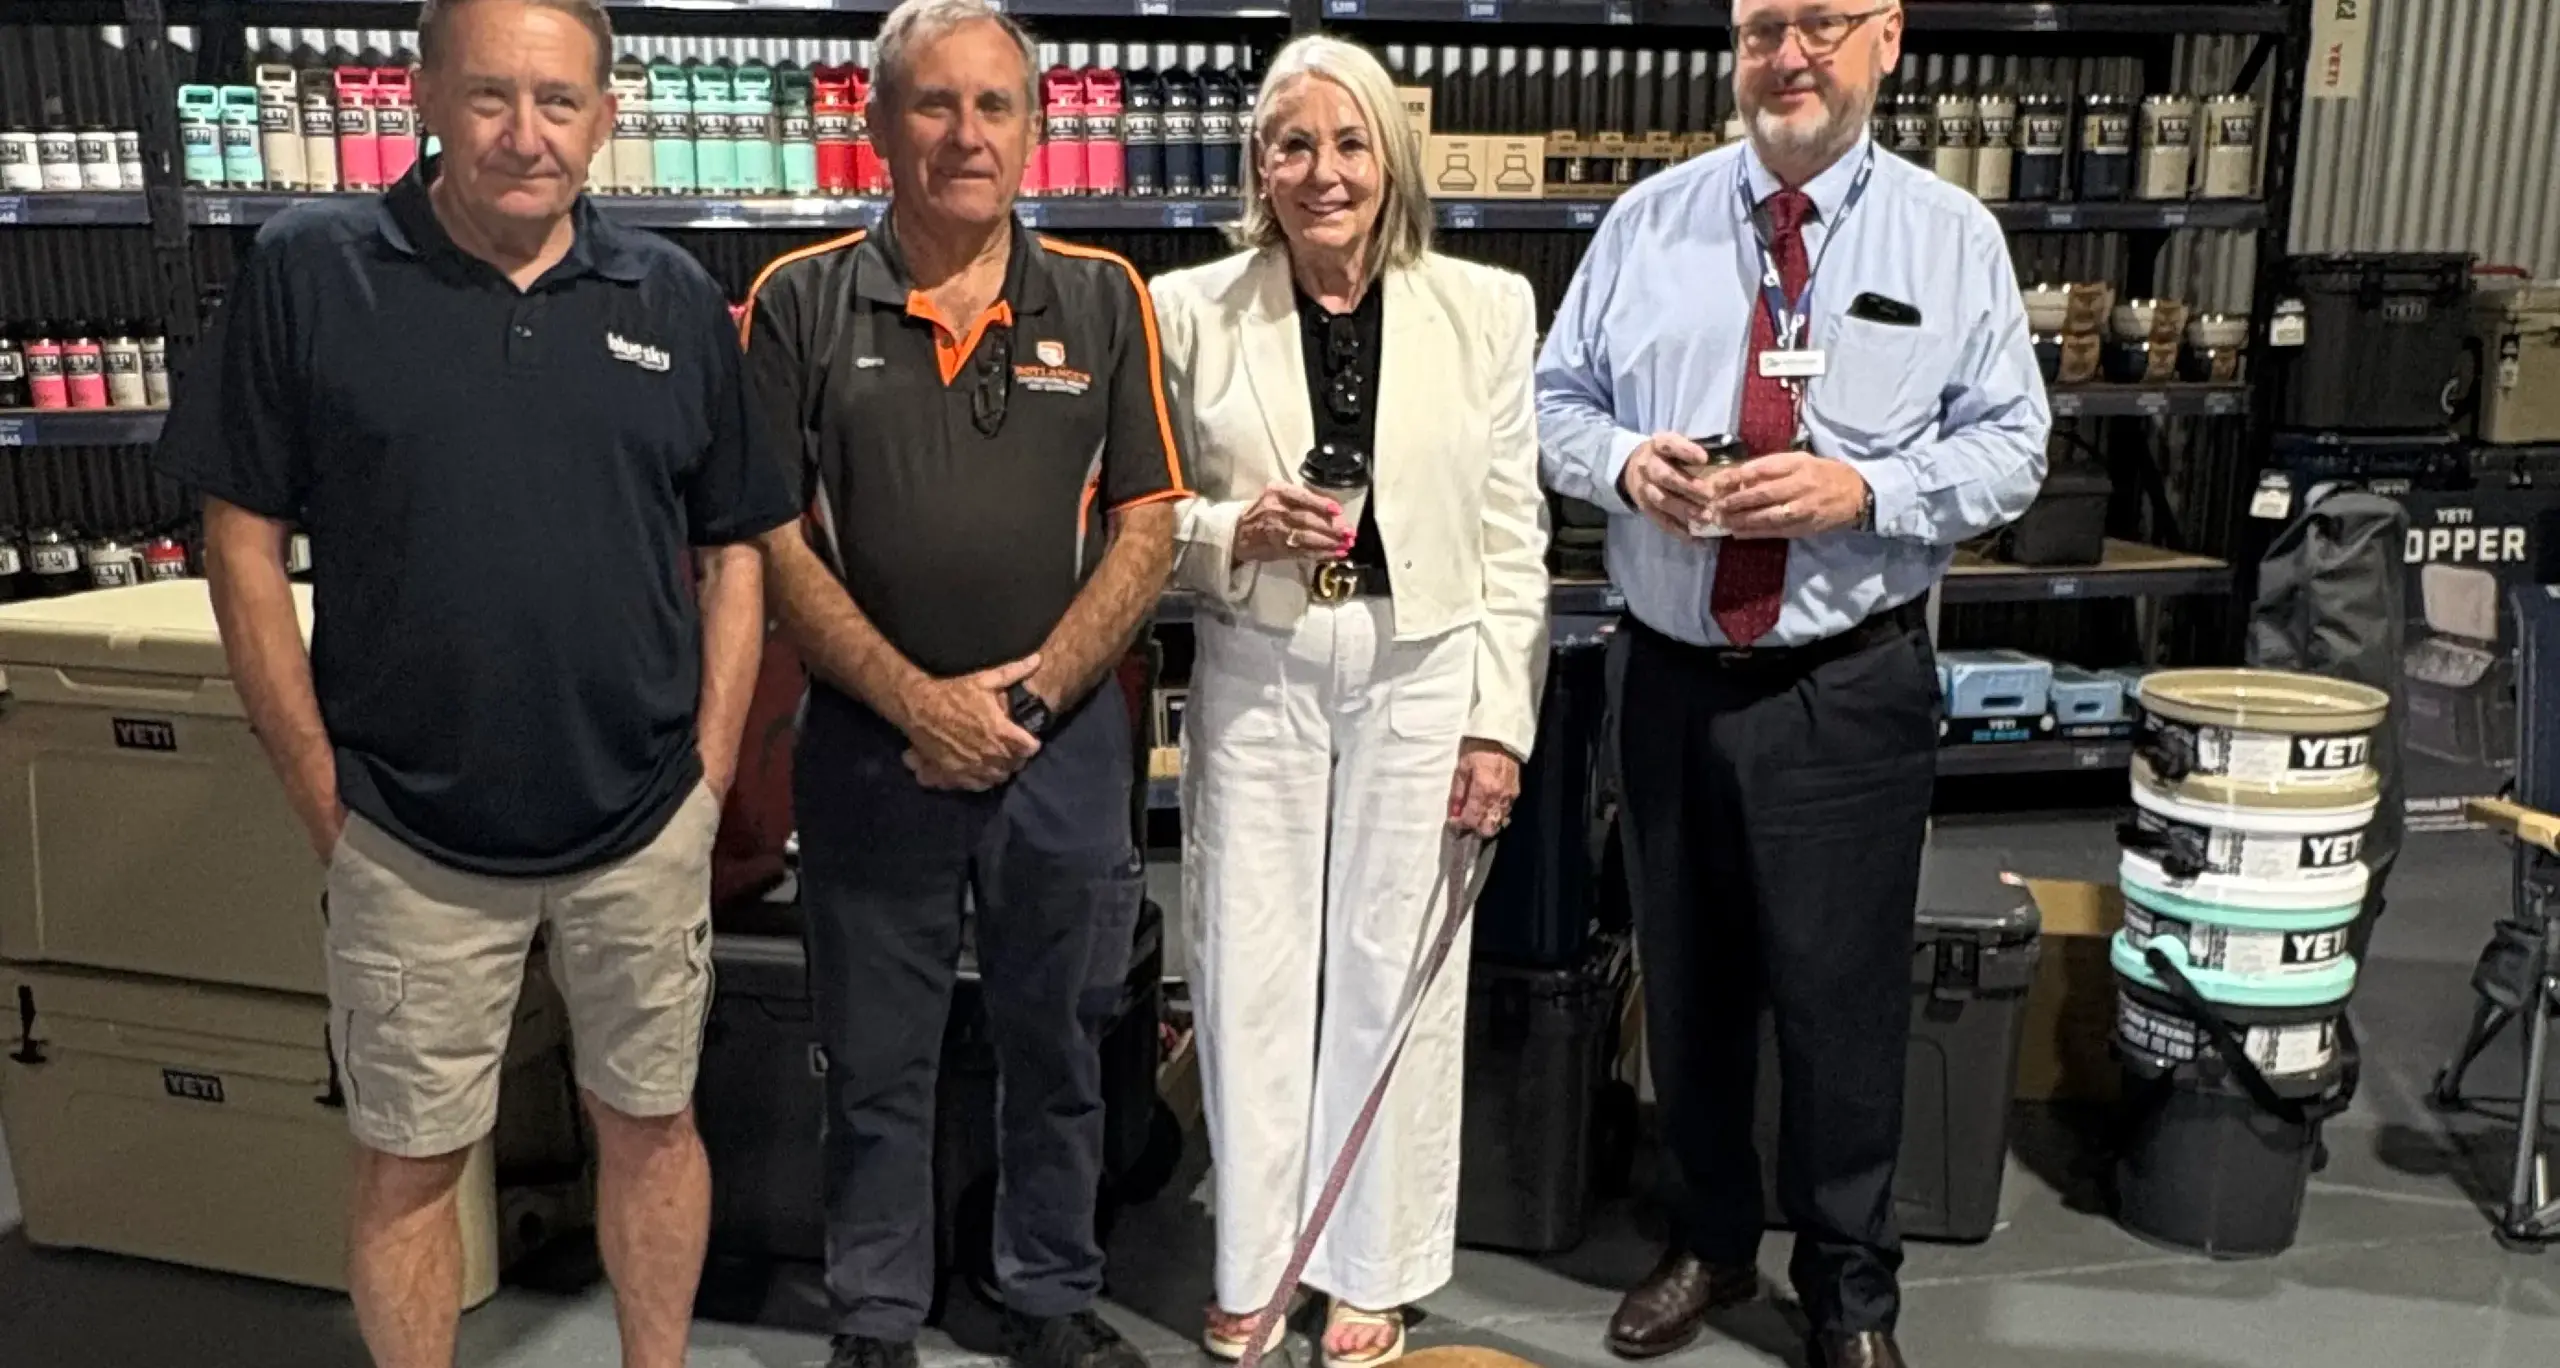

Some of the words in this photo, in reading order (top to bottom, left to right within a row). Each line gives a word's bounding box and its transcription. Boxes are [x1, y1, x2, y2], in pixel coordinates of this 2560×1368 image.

[615, 114, 647, 126] YETI
[655, 114, 687, 126] YETI
[700, 115, 731, 126] YETI
[1050, 118, 1079, 128] YETI
[1087, 117, 1116, 128] YETI
[1127, 117, 1157, 128] YETI
[1165, 117, 1196, 128] YETI
[1202, 117, 1232, 128] YETI
[2436, 508, 2472, 523] YETI
[2404, 527, 2526, 563] OPPER
[115, 722, 172, 747] YETI
[2299, 735, 2368, 767] YETI
[2308, 832, 2363, 866] YET
[166, 1074, 220, 1099] YETI
